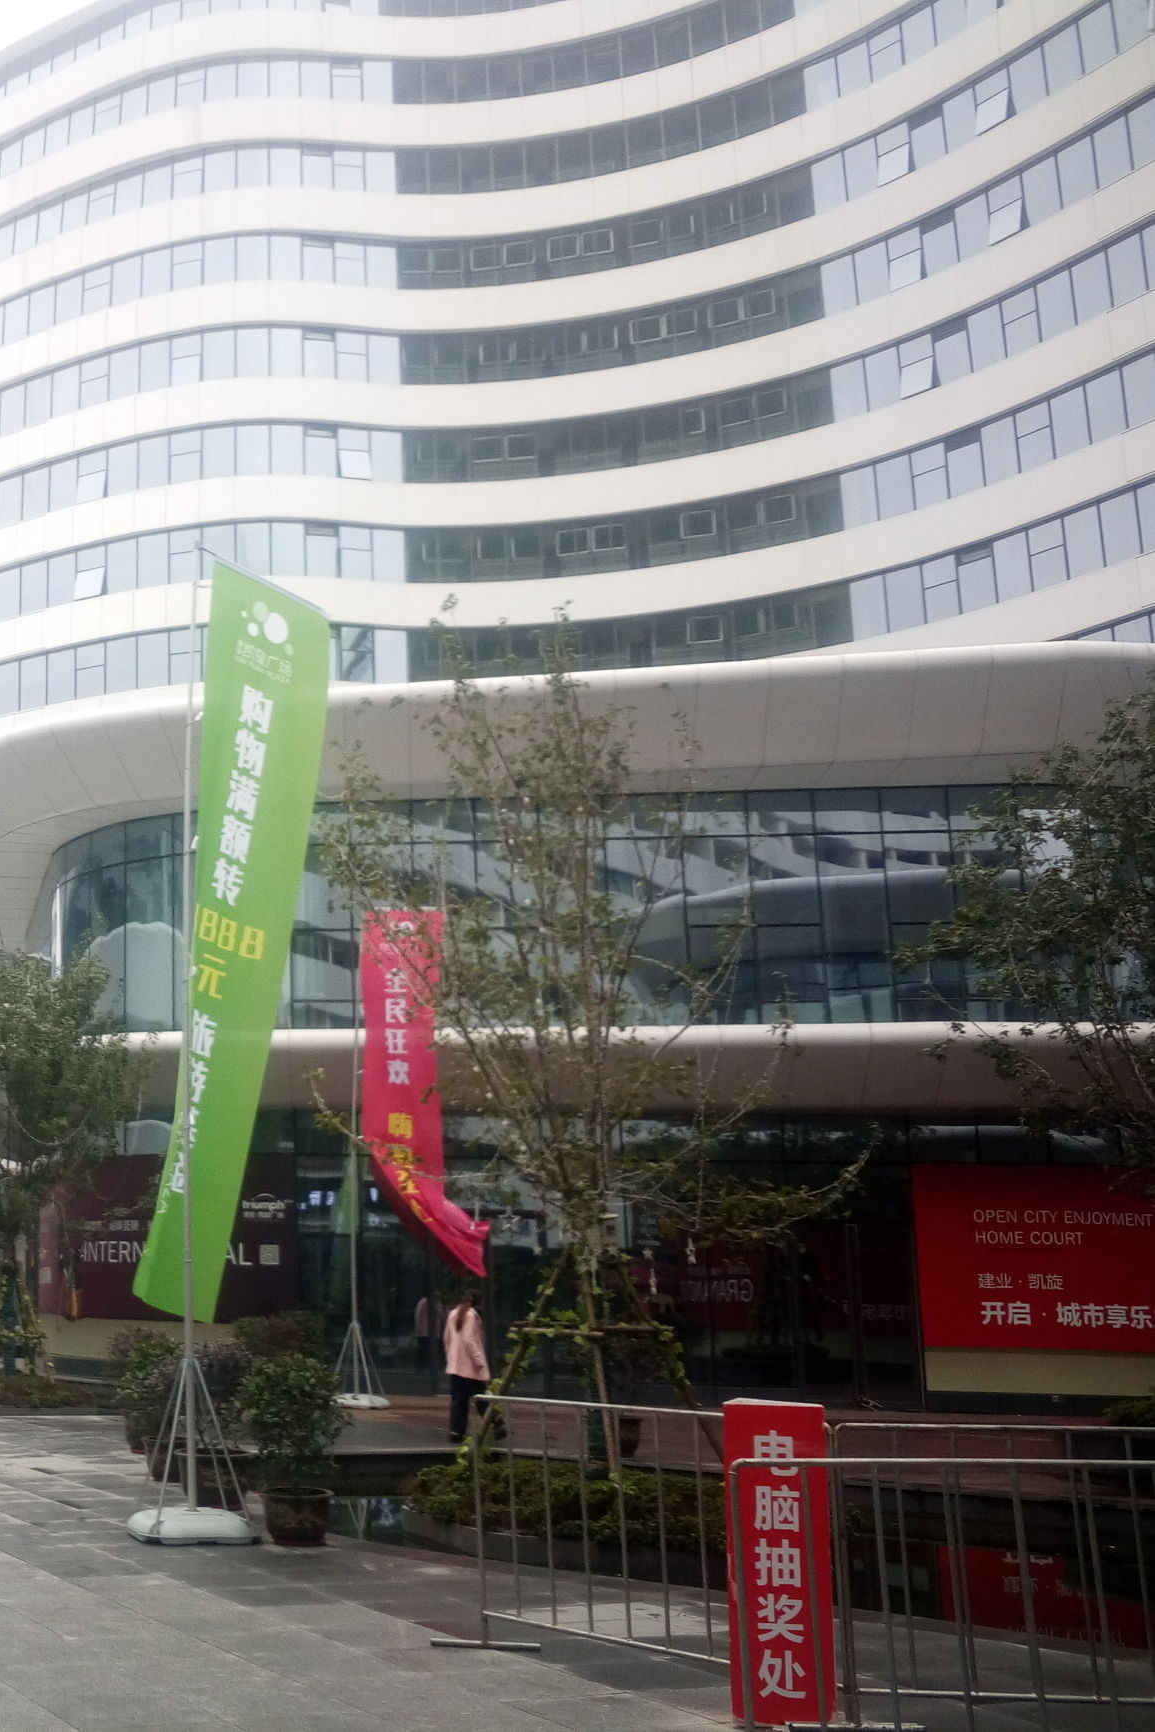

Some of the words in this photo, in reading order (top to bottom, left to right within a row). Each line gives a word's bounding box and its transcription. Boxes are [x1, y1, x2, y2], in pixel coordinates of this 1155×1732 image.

[973, 1209, 1018, 1224] OPEN
[1024, 1210, 1058, 1224] CITY
[1063, 1211, 1153, 1227] ENJOYMENT
[975, 1231, 1024, 1245] HOME
[1030, 1231, 1084, 1245] COURT
[752, 1429, 807, 1700] 电脑抽奖处
